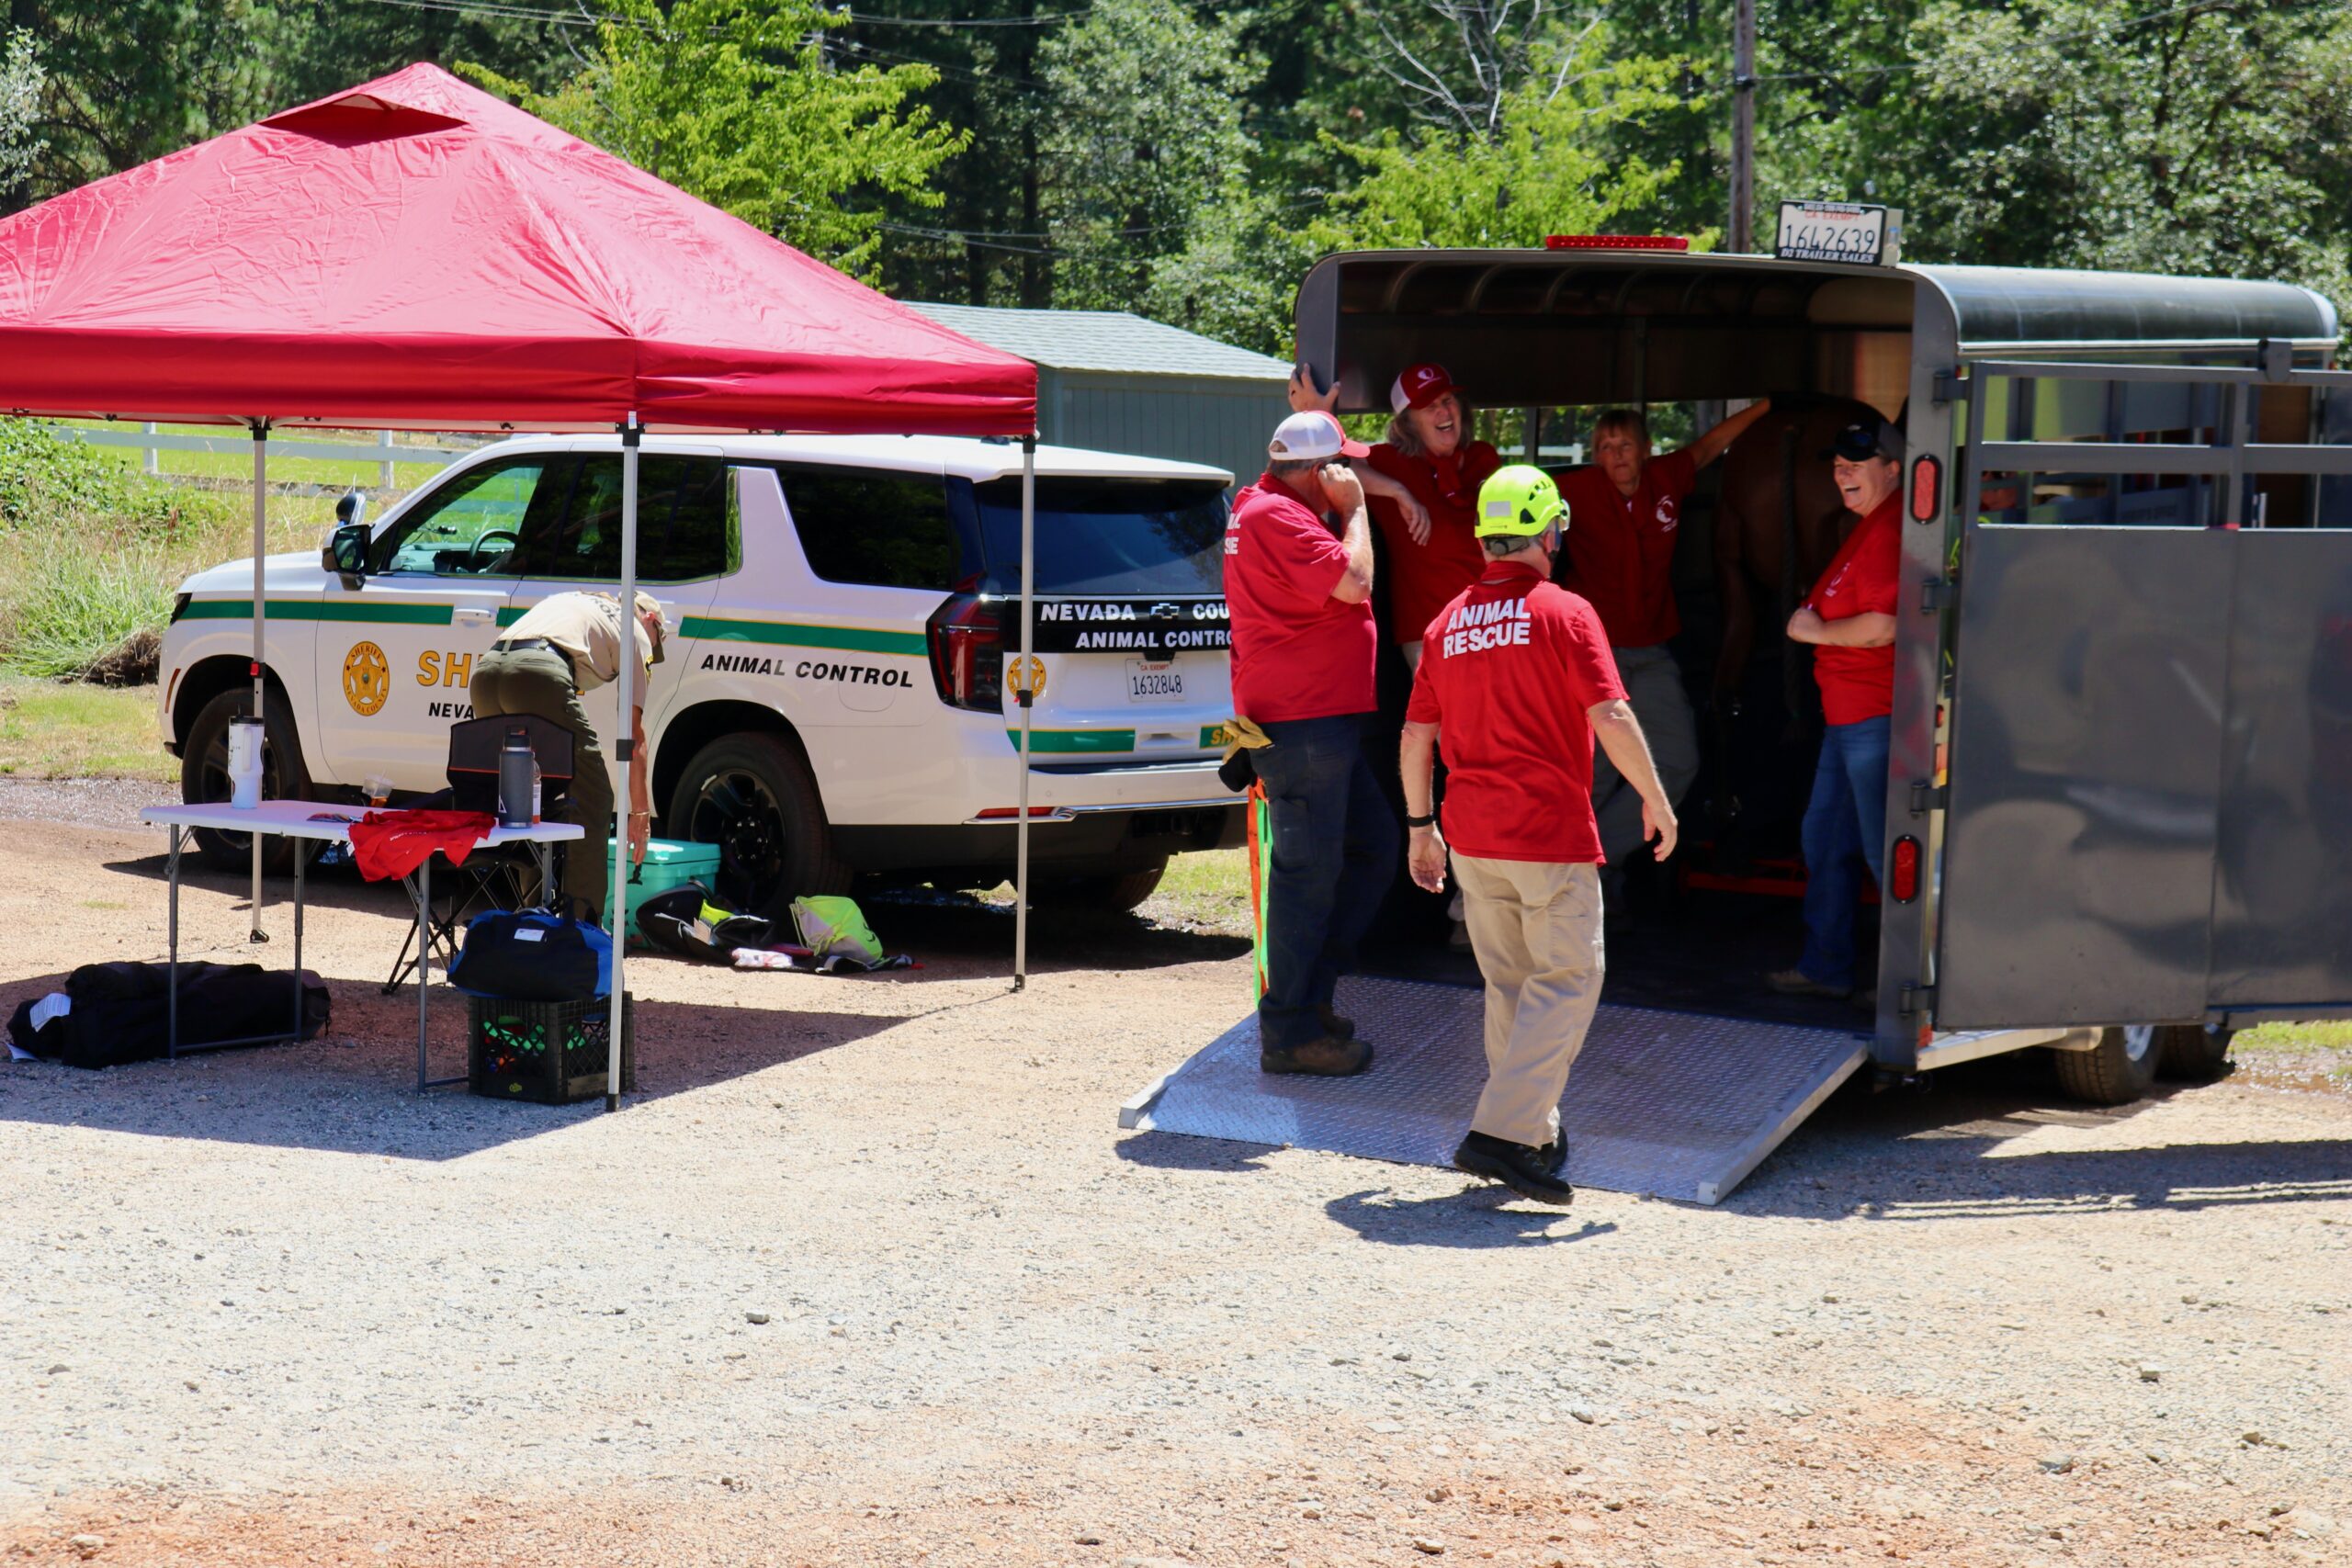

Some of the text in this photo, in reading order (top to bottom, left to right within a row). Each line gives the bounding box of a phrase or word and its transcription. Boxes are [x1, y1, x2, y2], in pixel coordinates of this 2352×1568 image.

[1785, 224, 1876, 254] 1642639
[1781, 247, 1875, 264] D2 TRAILER SALES
[1040, 603, 1231, 622] NEVADA COU
[1444, 597, 1532, 634] ANIMAL
[1075, 629, 1233, 649] ANIMAL CONTRO
[1442, 622, 1532, 660] RESCUE
[700, 653, 914, 689] ANIMAL CONTROL
[1132, 674, 1183, 695] 1632848
[428, 702, 476, 720] NEVA
